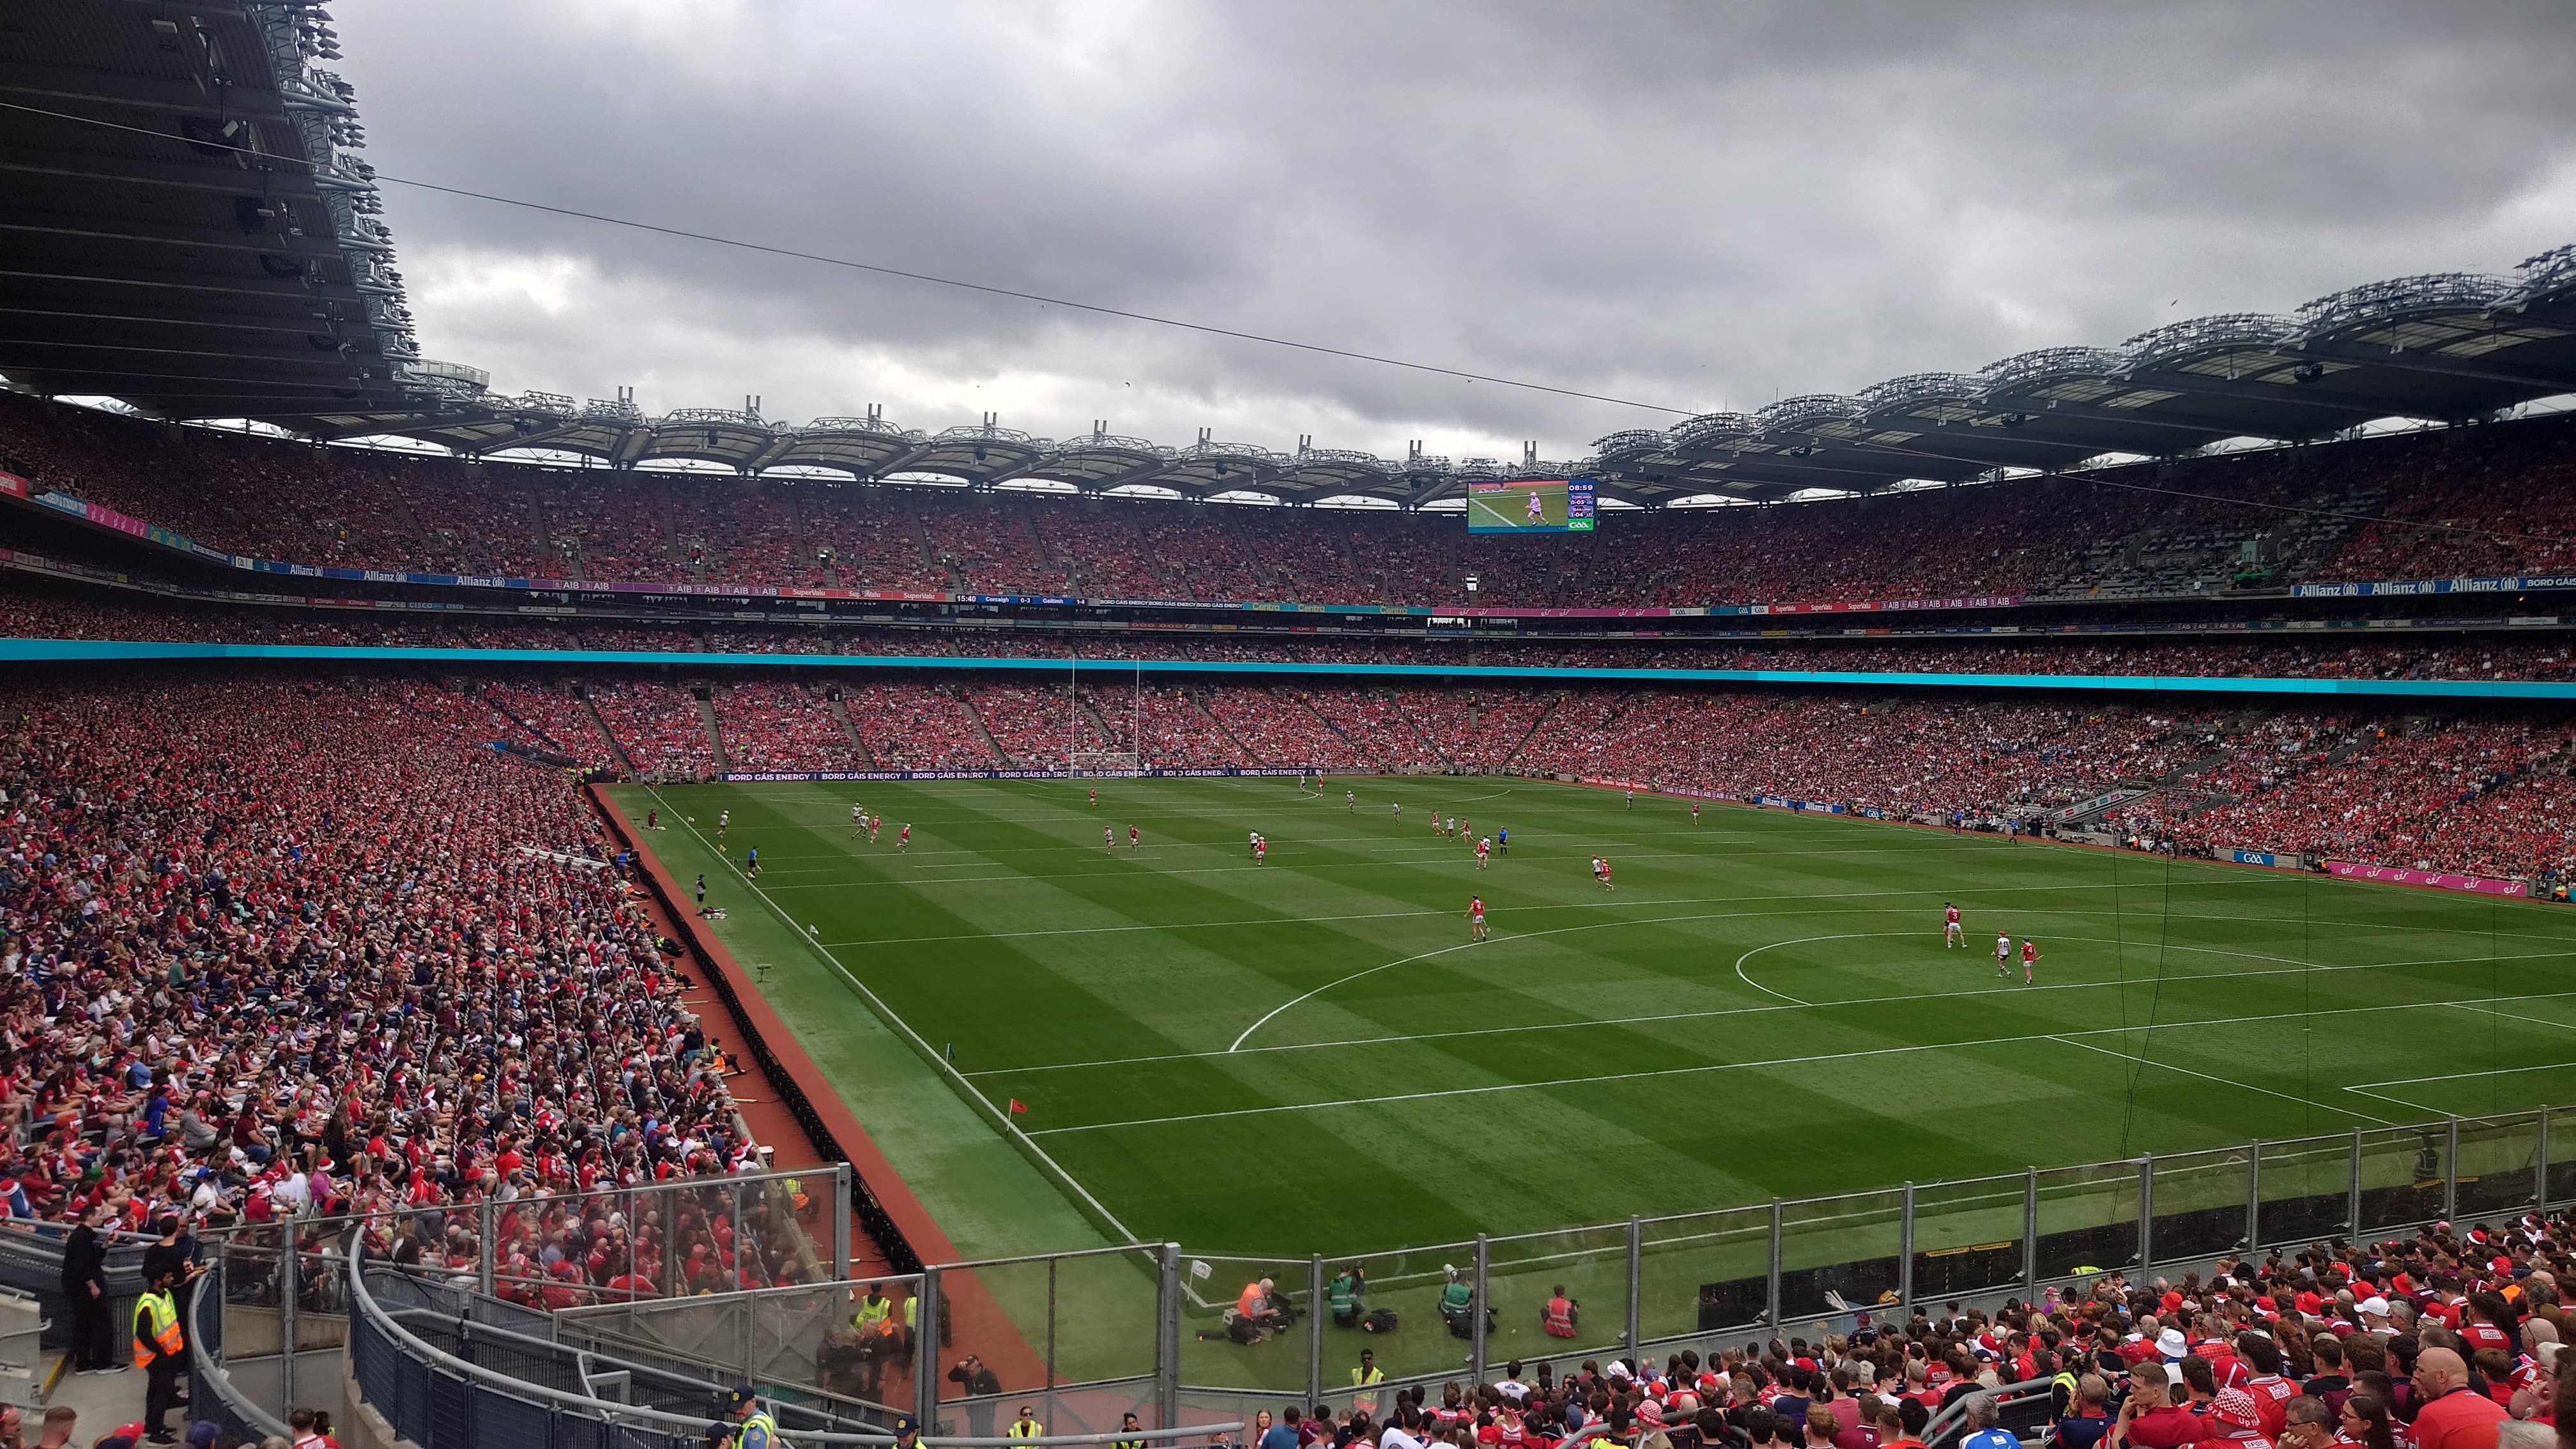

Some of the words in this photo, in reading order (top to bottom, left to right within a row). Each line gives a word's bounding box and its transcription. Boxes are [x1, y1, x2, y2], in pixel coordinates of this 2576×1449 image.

[290, 565, 314, 576] Allianz
[364, 571, 394, 582] Allianz
[456, 576, 491, 587] Allianz
[2300, 585, 2340, 597] Allianz
[2372, 582, 2415, 594] Allianz
[2450, 579, 2497, 592] Allianz
[848, 590, 880, 599] SupValu
[755, 772, 775, 781] GÁIS
[848, 772, 866, 780] GÁIS
[938, 771, 956, 779] GÁIS
[1762, 797, 1780, 807] Allianz
[1805, 802, 1825, 811] Allianz
[2243, 854, 2264, 865] GAA
[2341, 864, 2355, 874] eir
[2367, 868, 2382, 877] eir
[2394, 870, 2409, 880] eir
[2425, 874, 2442, 884] eir
[2464, 879, 2481, 889] eir
[2503, 883, 2521, 893] eir
[2547, 1213, 2560, 1224] 41
[2239, 1416, 2250, 1427] Up
